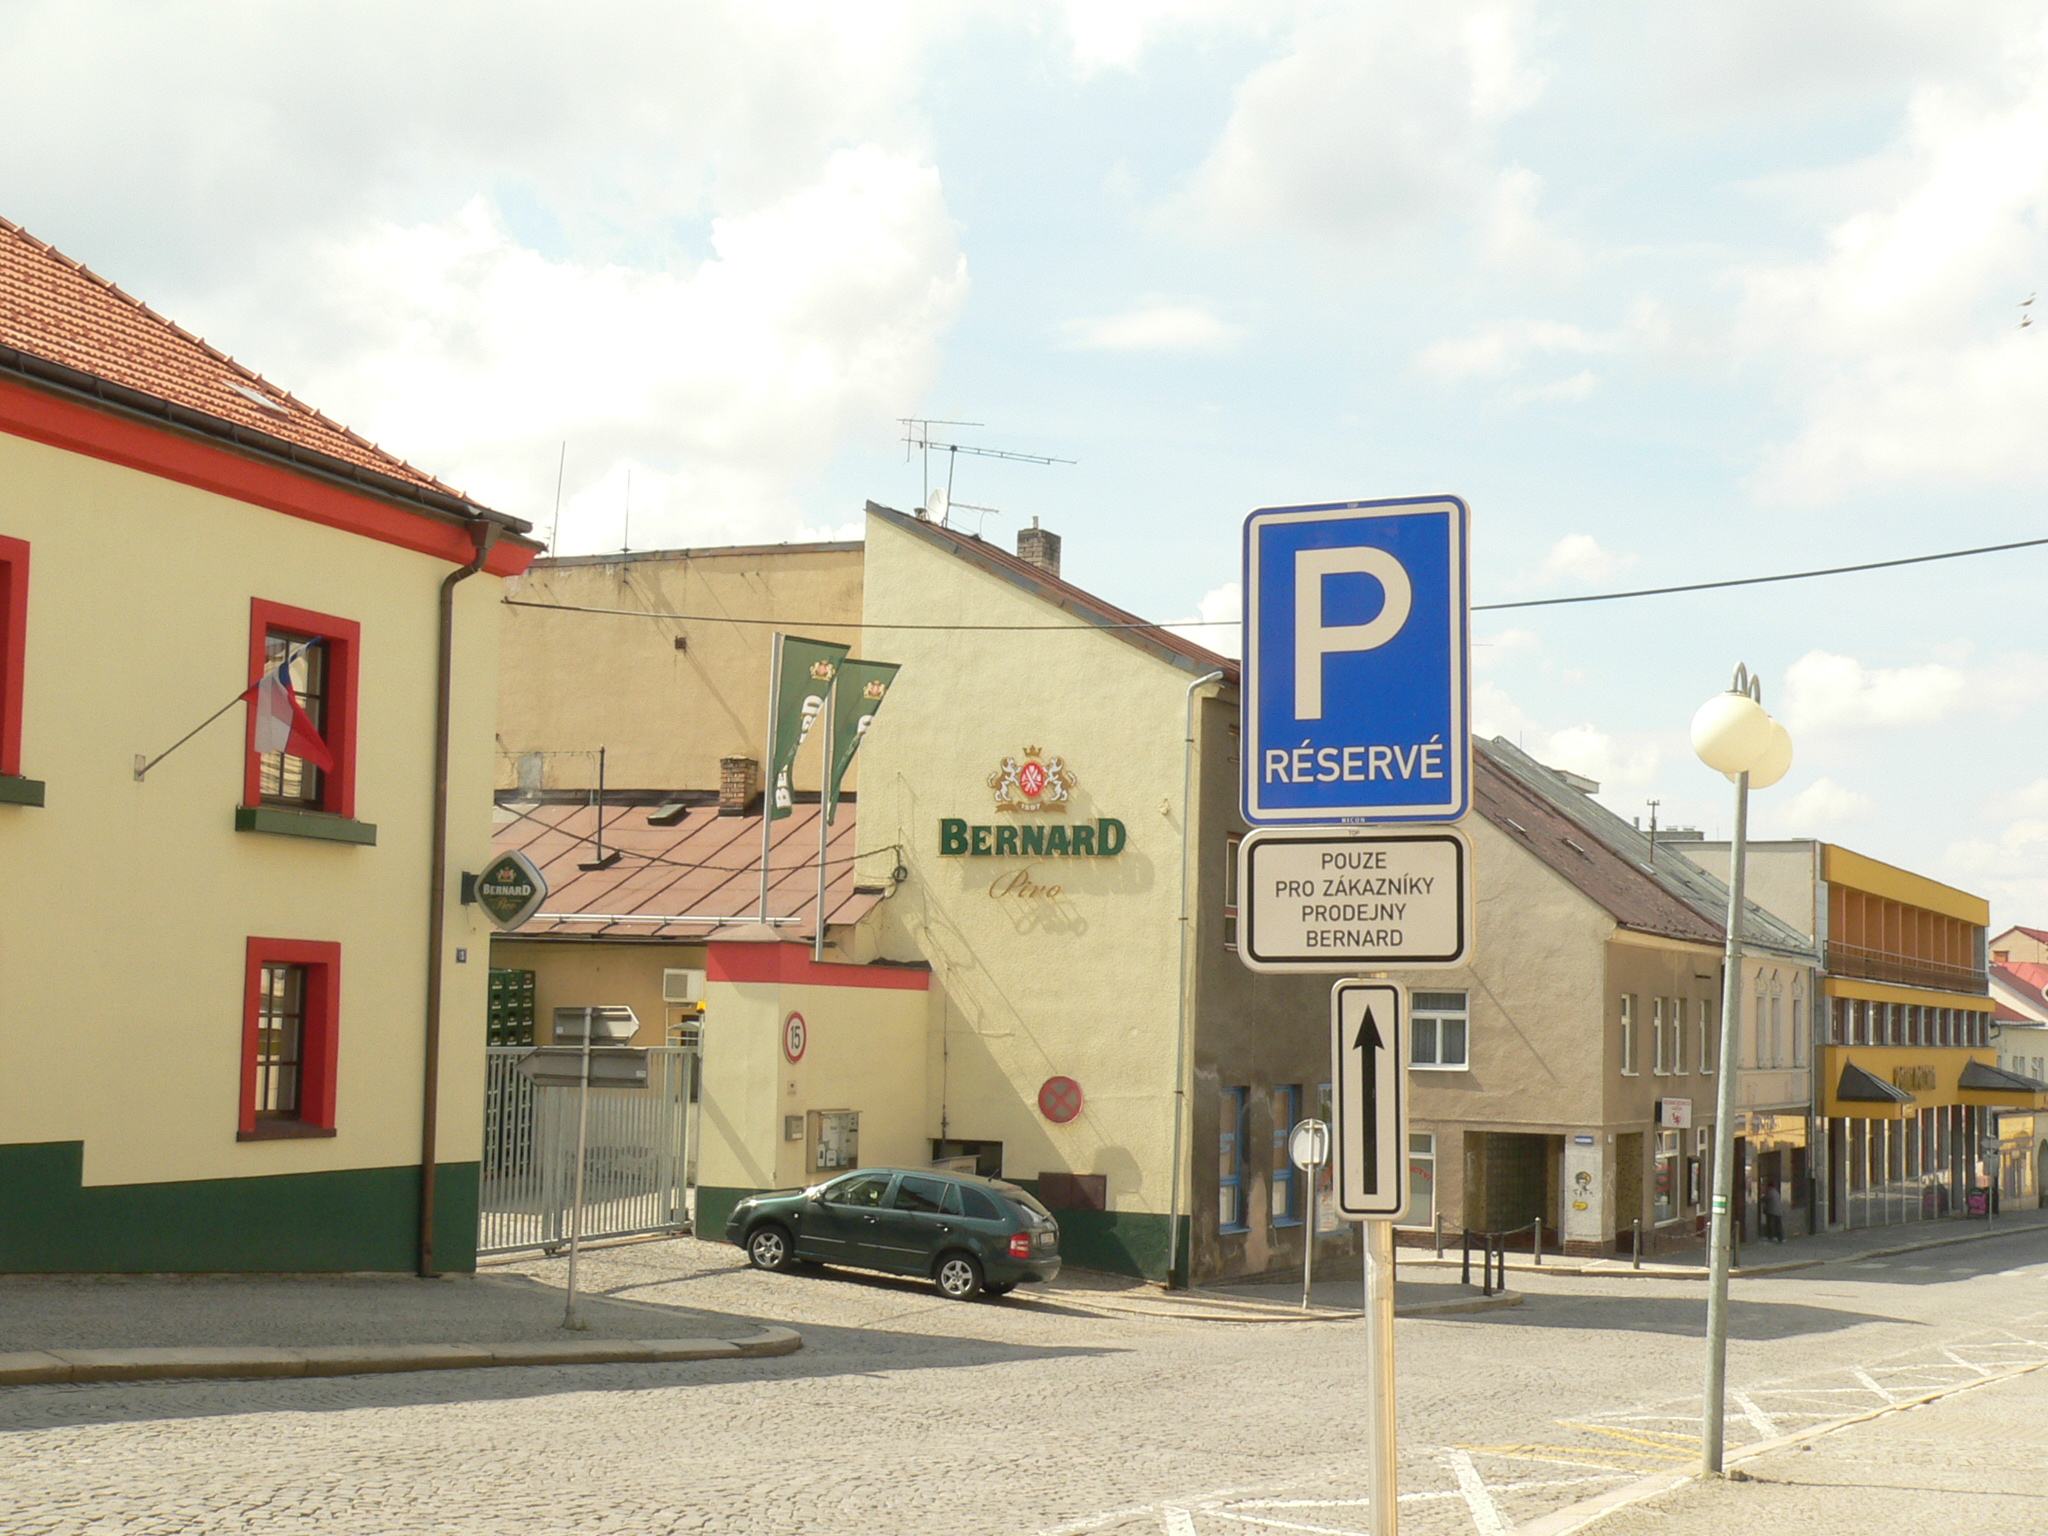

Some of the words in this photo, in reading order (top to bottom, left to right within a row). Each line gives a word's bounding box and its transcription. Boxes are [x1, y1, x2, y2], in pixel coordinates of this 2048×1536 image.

[1294, 545, 1412, 720] P
[1265, 734, 1443, 784] RÉSERVÉ
[1020, 803, 1041, 811] 1597
[938, 818, 1127, 857] BERNARD
[1322, 852, 1387, 870] POUZE
[482, 883, 531, 896] BERNARD
[989, 861, 1061, 899] Pivo
[1275, 880, 1315, 898] PRO
[1322, 873, 1434, 897] ZÁKAZNÍKY
[1302, 903, 1406, 922] PRODEJNY
[1306, 929, 1403, 947] BERNARD
[790, 1025, 801, 1050] 15
